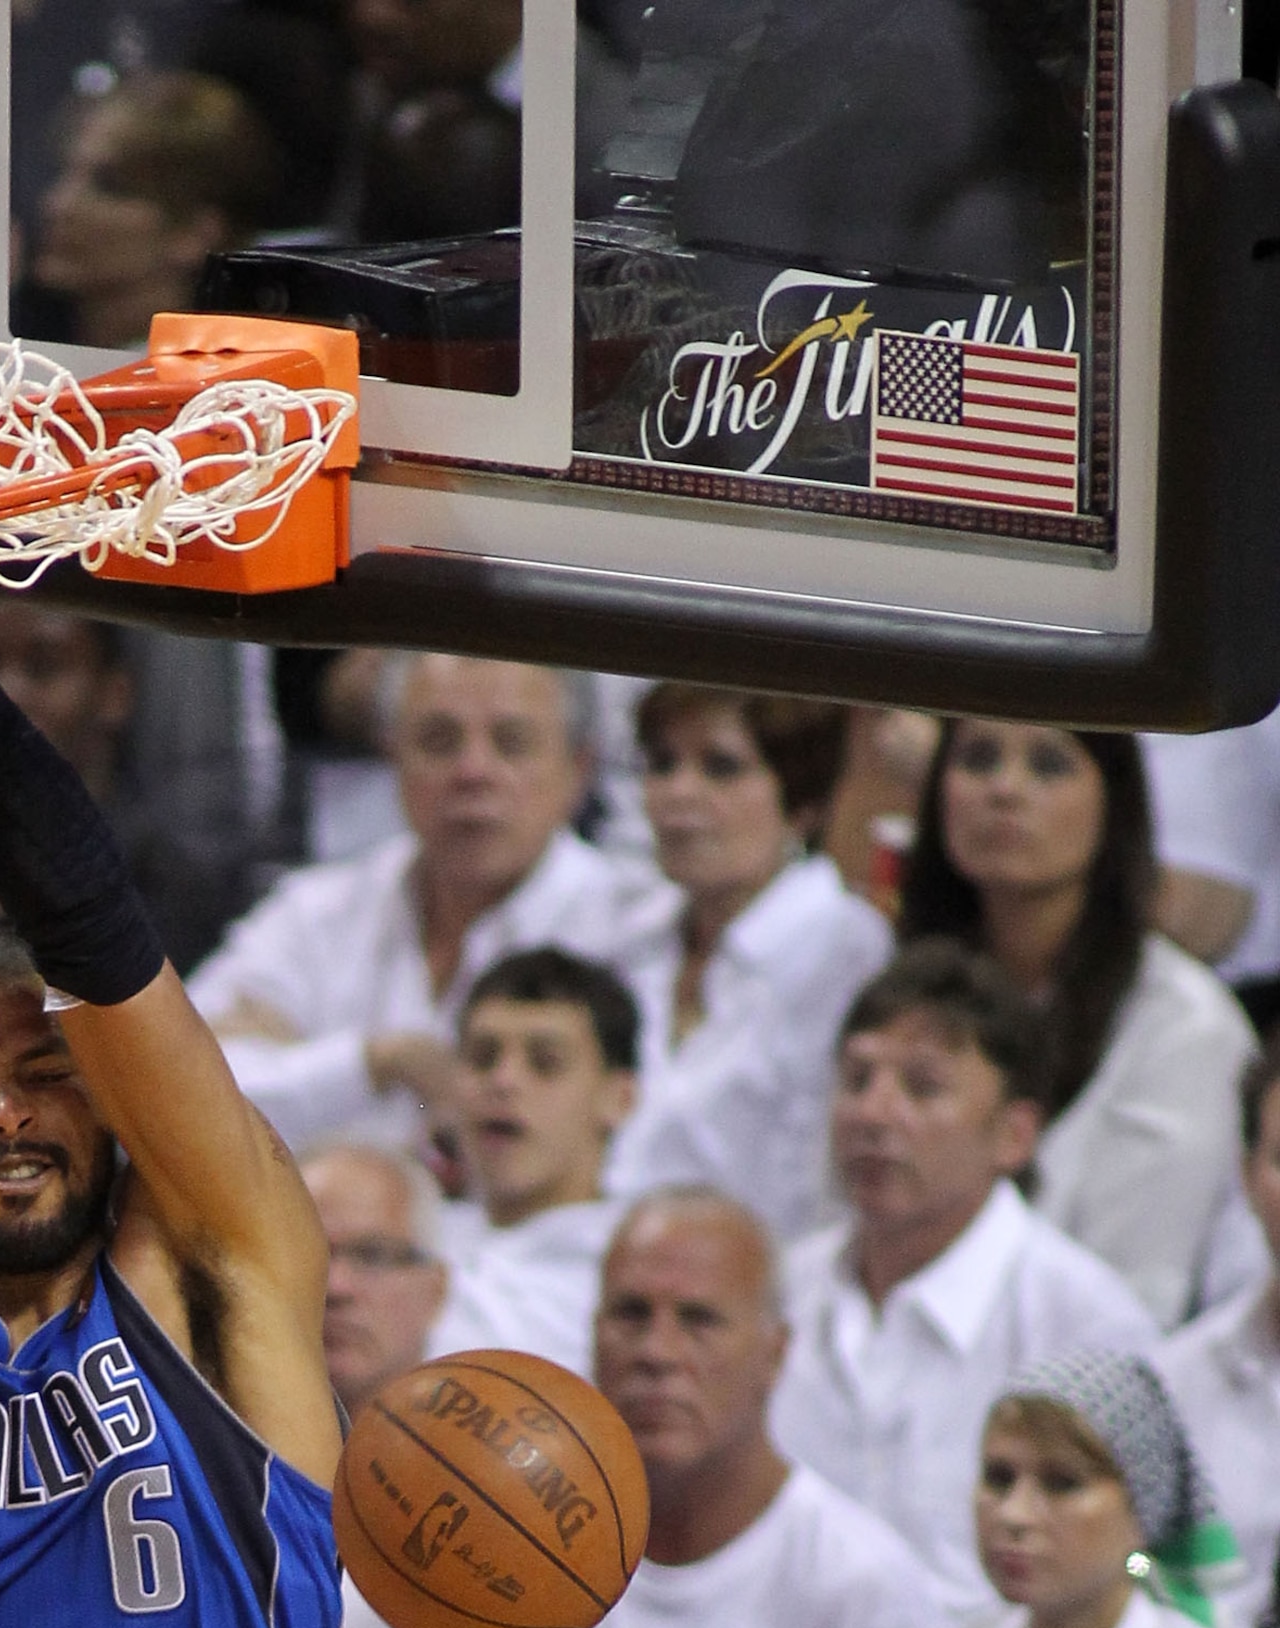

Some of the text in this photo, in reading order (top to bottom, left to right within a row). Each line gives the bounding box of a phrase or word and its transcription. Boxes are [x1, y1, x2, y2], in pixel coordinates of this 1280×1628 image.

[657, 331, 776, 449] The
[417, 1377, 597, 1549] SPALDING
[103, 1464, 185, 1613] 6
